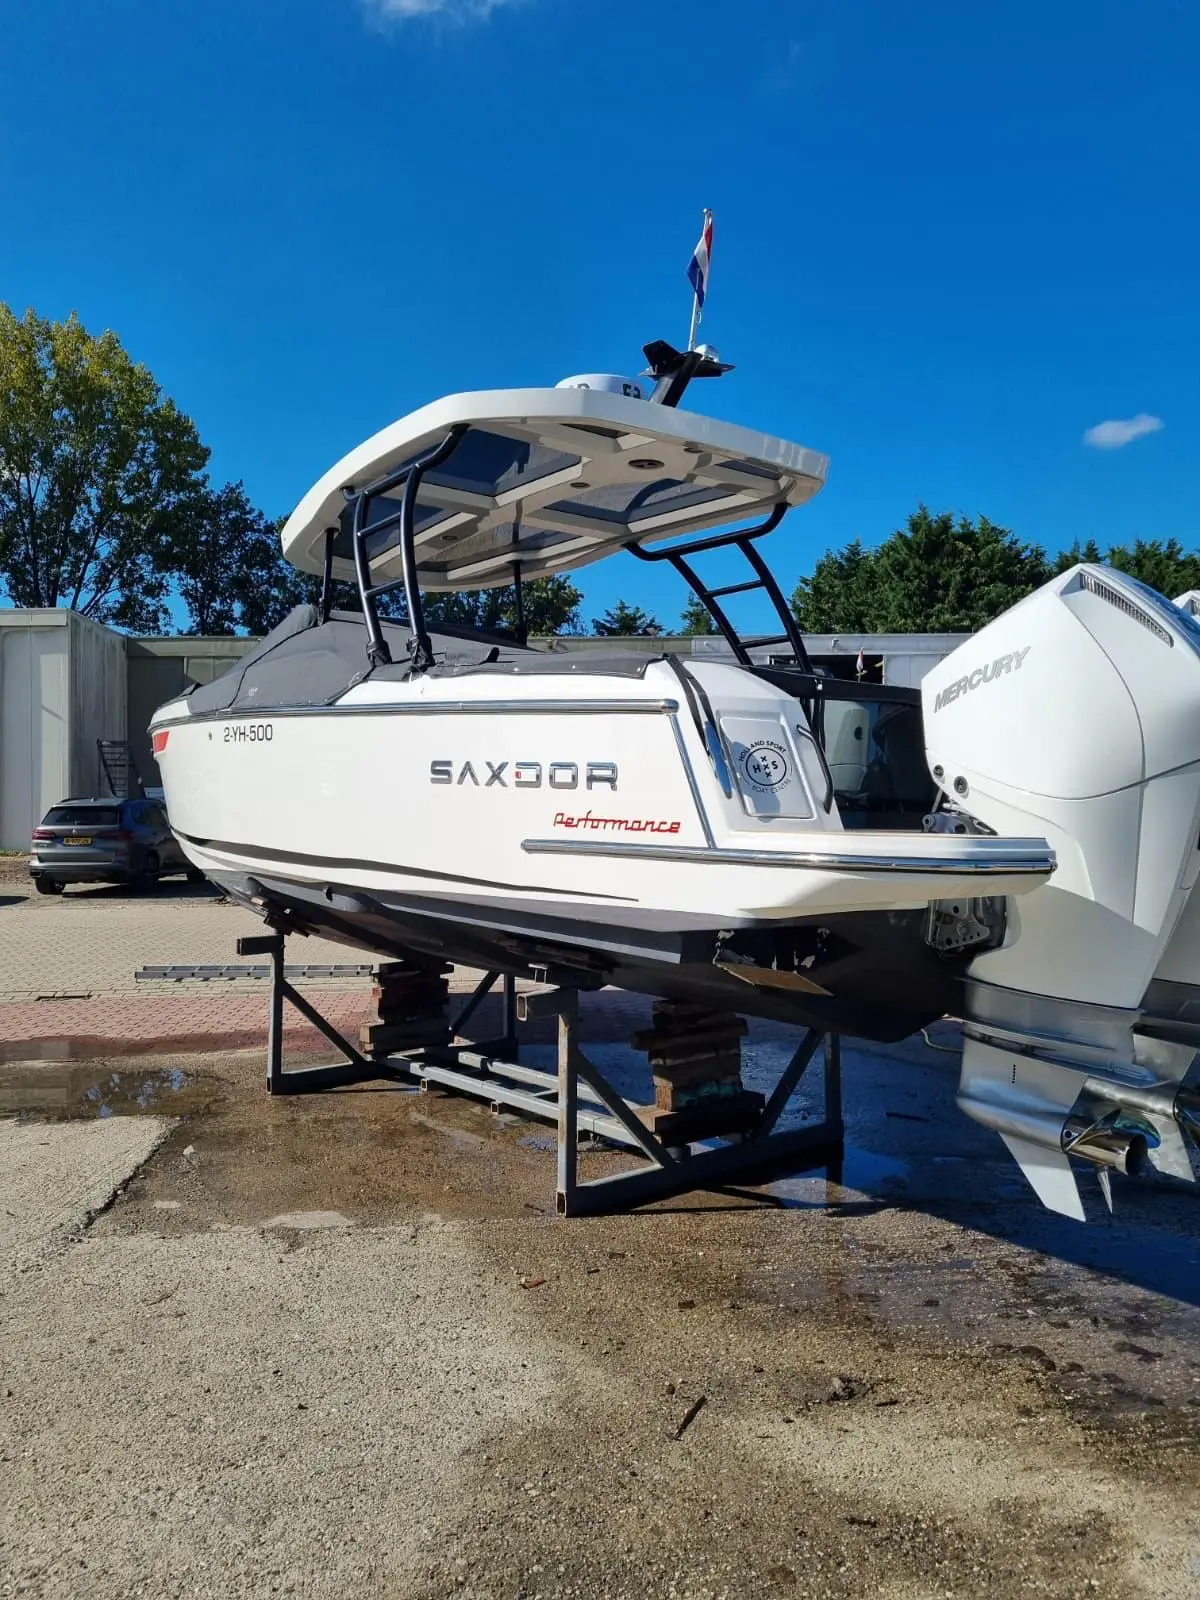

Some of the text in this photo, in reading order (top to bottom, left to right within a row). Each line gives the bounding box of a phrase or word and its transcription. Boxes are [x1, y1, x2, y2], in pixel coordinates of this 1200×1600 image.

[934, 646, 1032, 713] MERCURY
[223, 724, 273, 743] 2-YH-500
[739, 740, 786, 761] HOLLAND SPORT
[430, 760, 618, 792] SAXDOR
[553, 810, 681, 833] Performance
